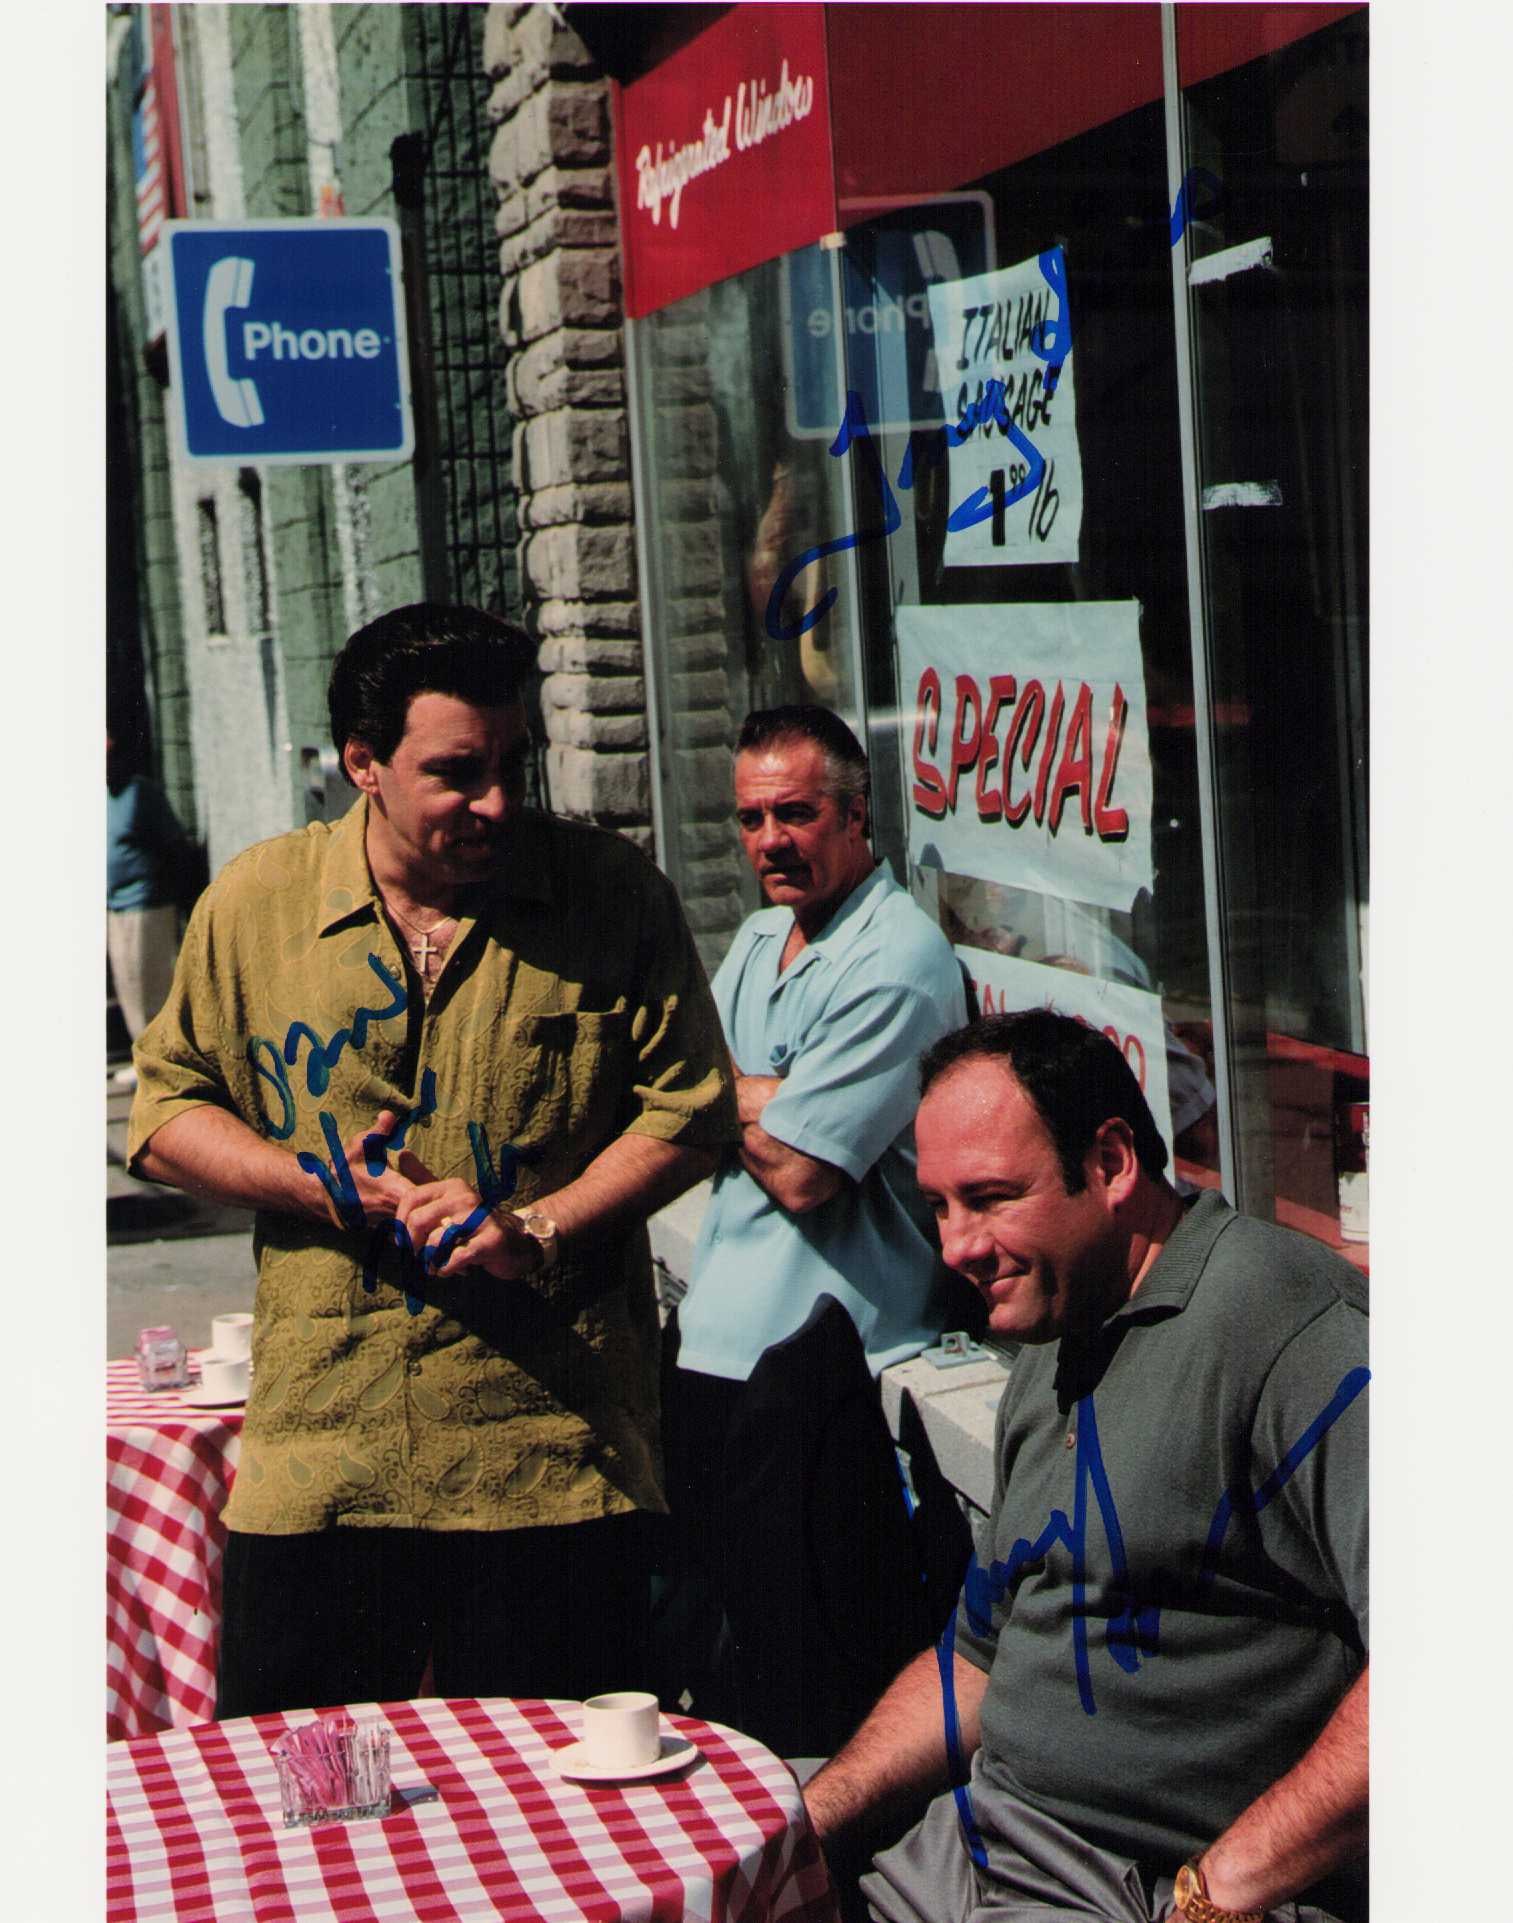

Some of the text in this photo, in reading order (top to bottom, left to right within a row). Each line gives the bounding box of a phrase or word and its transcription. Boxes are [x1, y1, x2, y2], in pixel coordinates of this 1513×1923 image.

[243, 321, 381, 361] Phone
[956, 287, 1051, 371] ITALIAN
[912, 667, 1129, 843] SPECIAL
